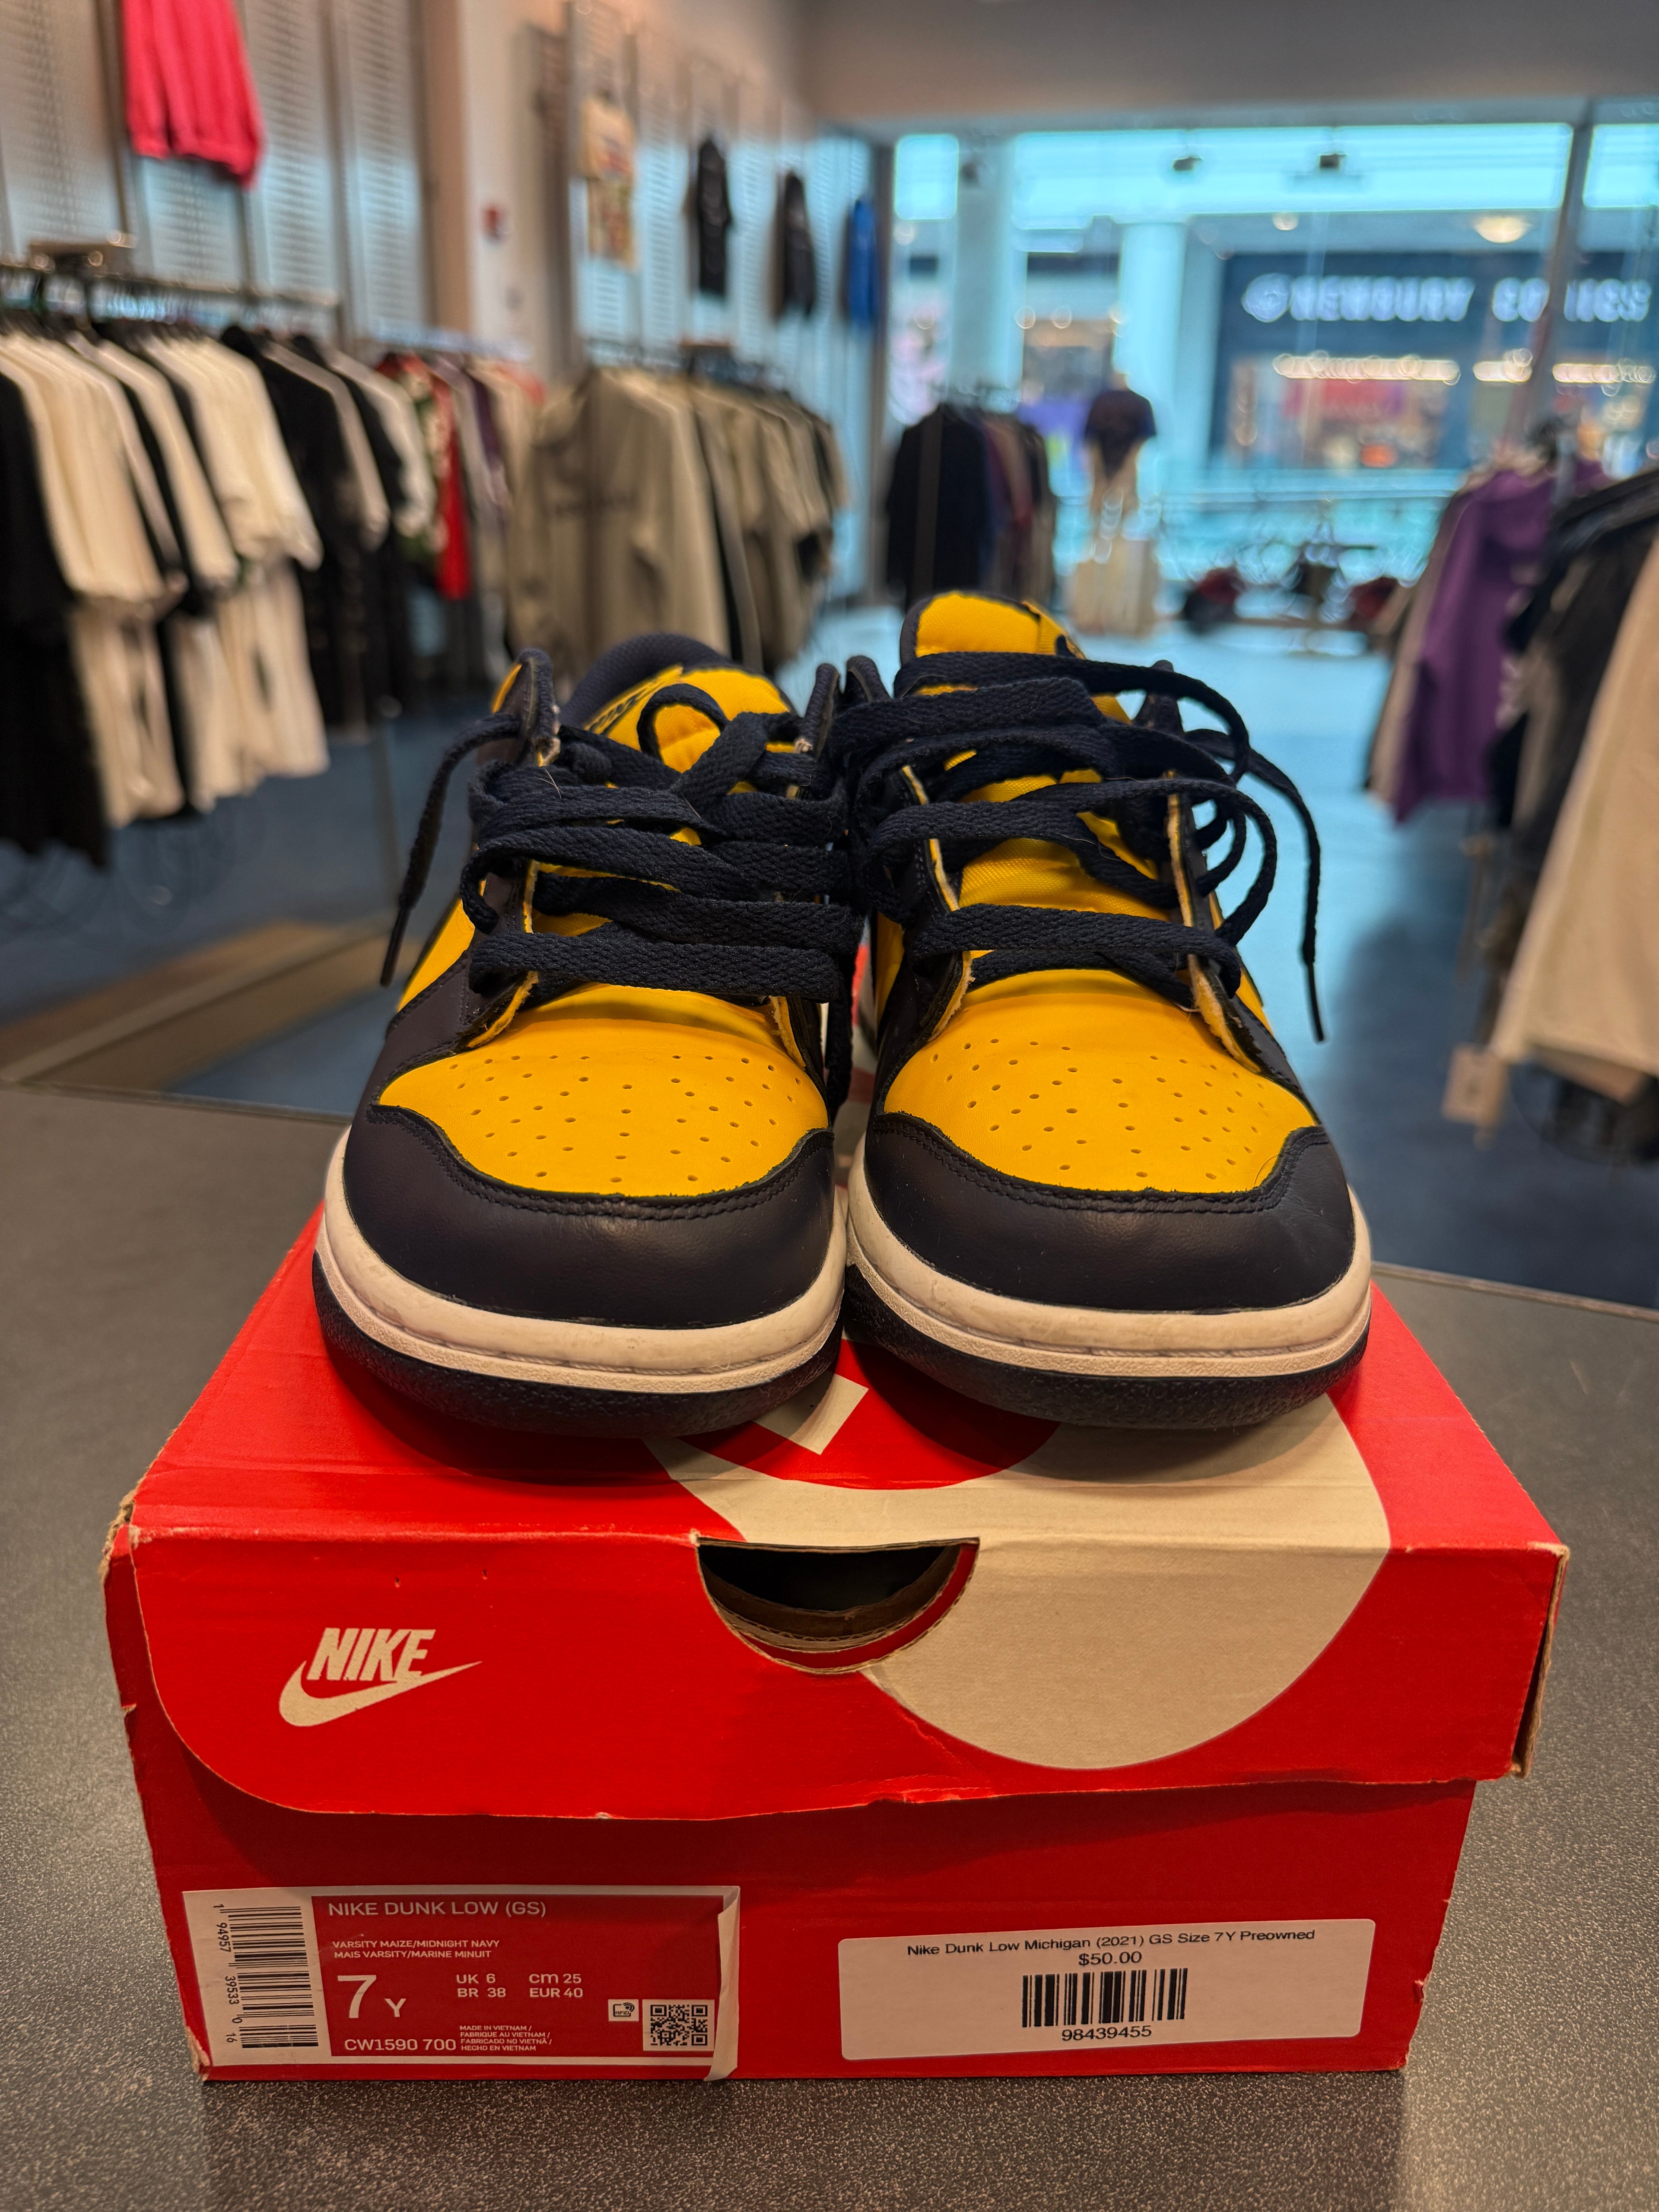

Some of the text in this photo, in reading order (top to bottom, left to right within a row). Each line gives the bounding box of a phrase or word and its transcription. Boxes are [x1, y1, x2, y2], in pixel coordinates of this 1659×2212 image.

[1290, 275, 1475, 322] NEWBURY
[307, 1627, 436, 1681] NIKE
[328, 1901, 546, 1917] NIKE DUNK LOW (GS)
[380, 1940, 468, 1948] MAIZE/MIDNIGHT
[907, 1945, 940, 1955] Nike
[945, 1943, 984, 1954] Dunk
[989, 1942, 1020, 1952] Low
[1025, 1938, 1090, 1951] Michigan
[1096, 1936, 1144, 1949] (2021)
[1149, 1933, 1173, 1944] GS
[1178, 1932, 1210, 1943] Size
[1240, 1929, 1315, 1941] Preowned
[216, 1923, 231, 1952] 94957
[225, 1976, 239, 2005] 39533
[1078, 1951, 1142, 1967] $50.00
[456, 1974, 496, 1984] UK 6
[529, 1974, 582, 1984] cm 25
[337, 1975, 407, 2018] 7 Y
[457, 1987, 506, 1998] BR 38
[530, 1987, 583, 1998] EUR 40
[226, 2033, 237, 2043] 16
[1062, 2025, 1152, 2041] 98439455
[344, 2039, 456, 2051] CW1590 700
